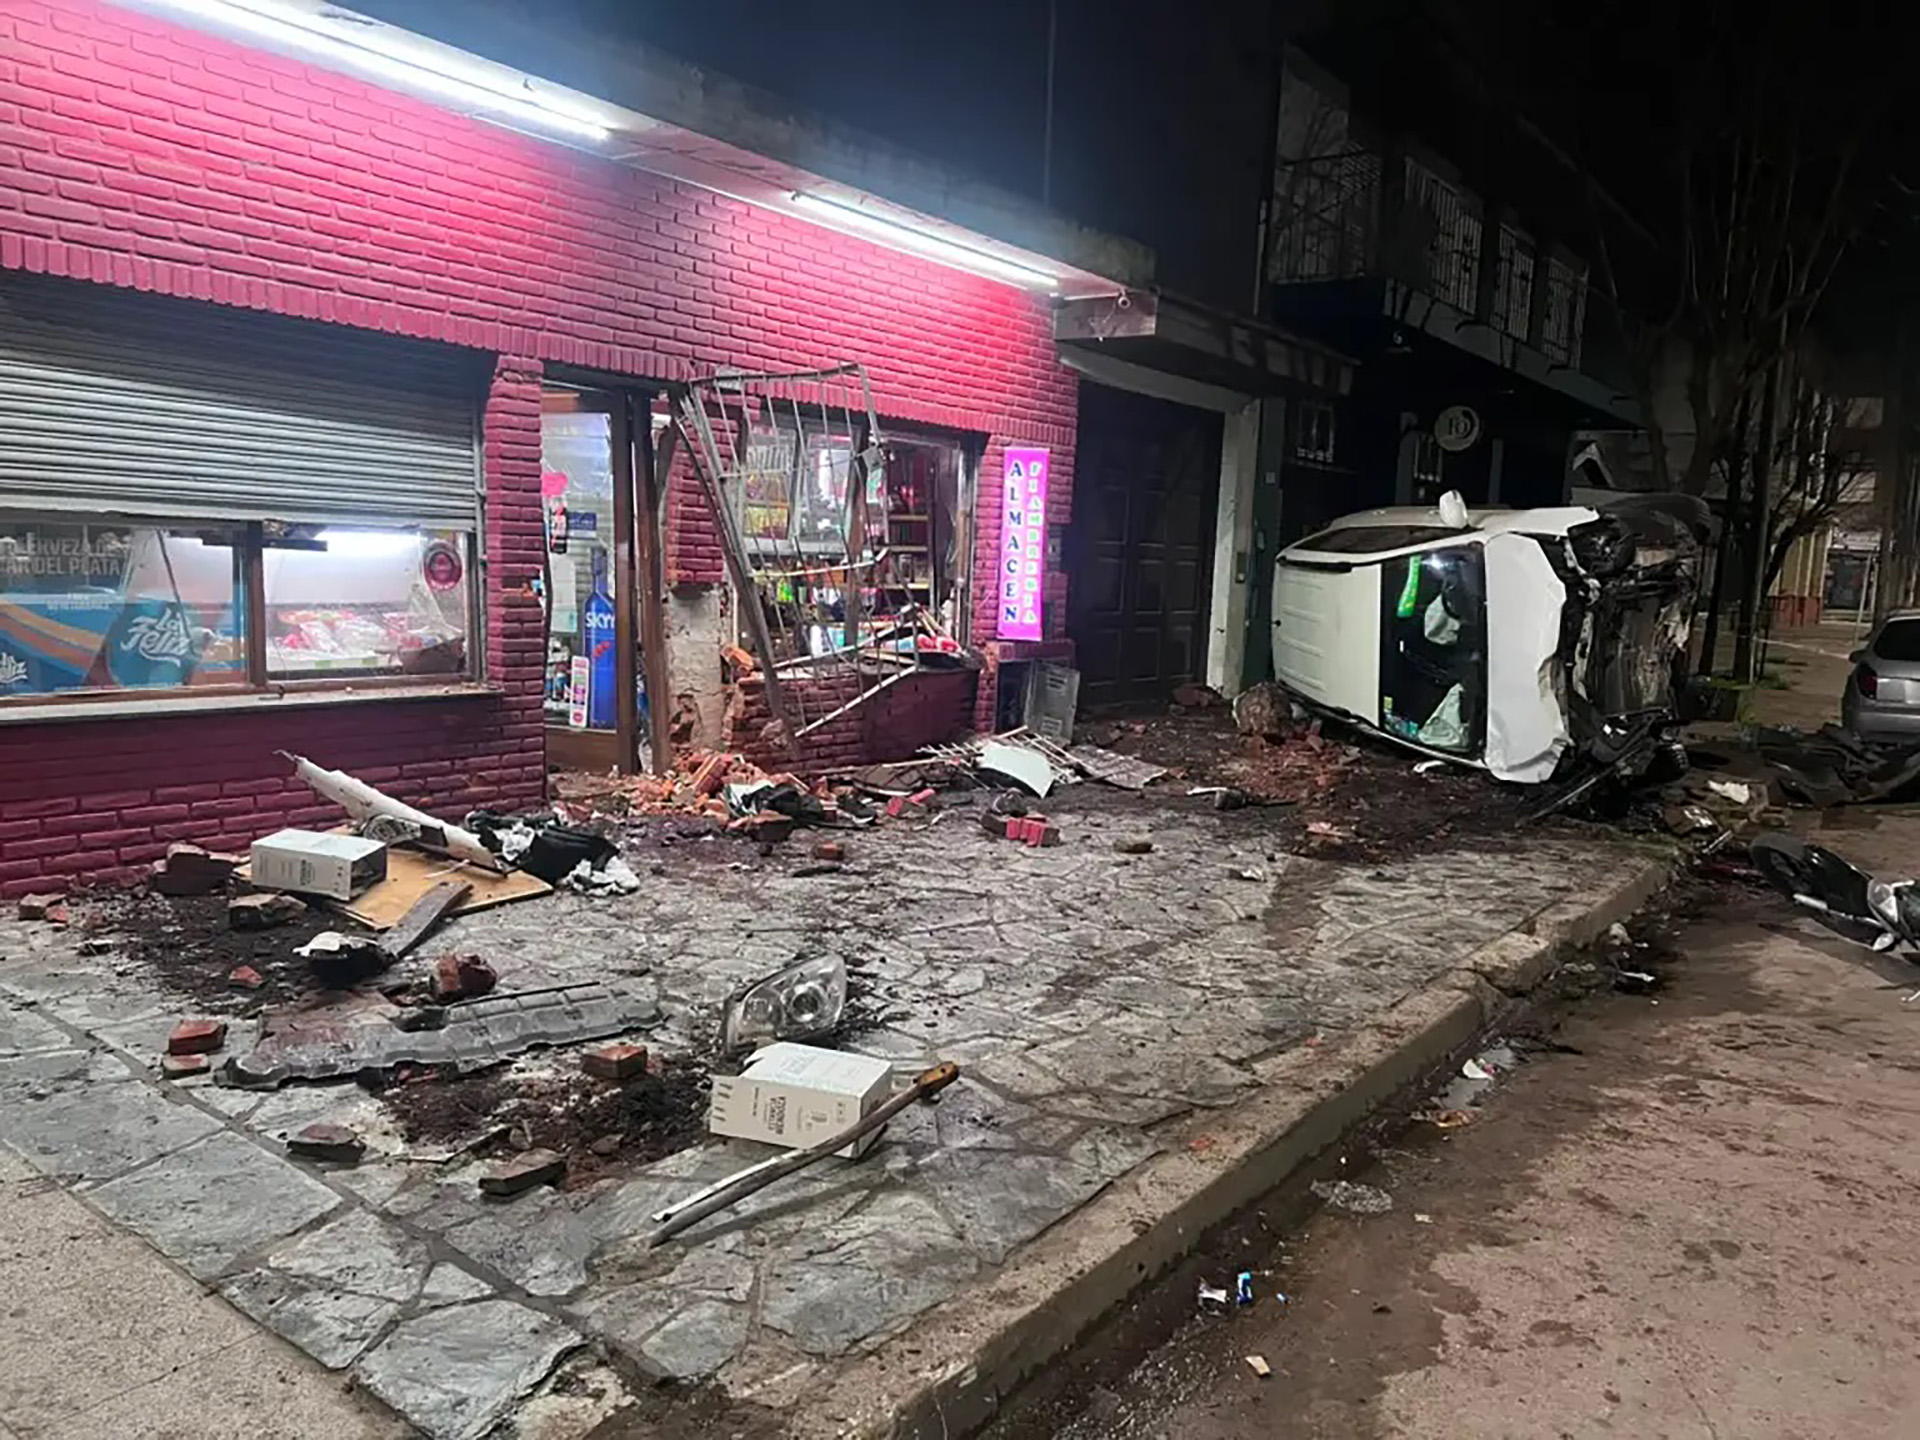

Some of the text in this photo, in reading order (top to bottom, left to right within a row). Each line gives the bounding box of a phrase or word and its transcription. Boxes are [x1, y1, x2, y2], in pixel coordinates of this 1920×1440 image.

[32, 556, 66, 575] DEL
[69, 556, 121, 576] PLATA
[1004, 462, 1023, 622] ALMACEN
